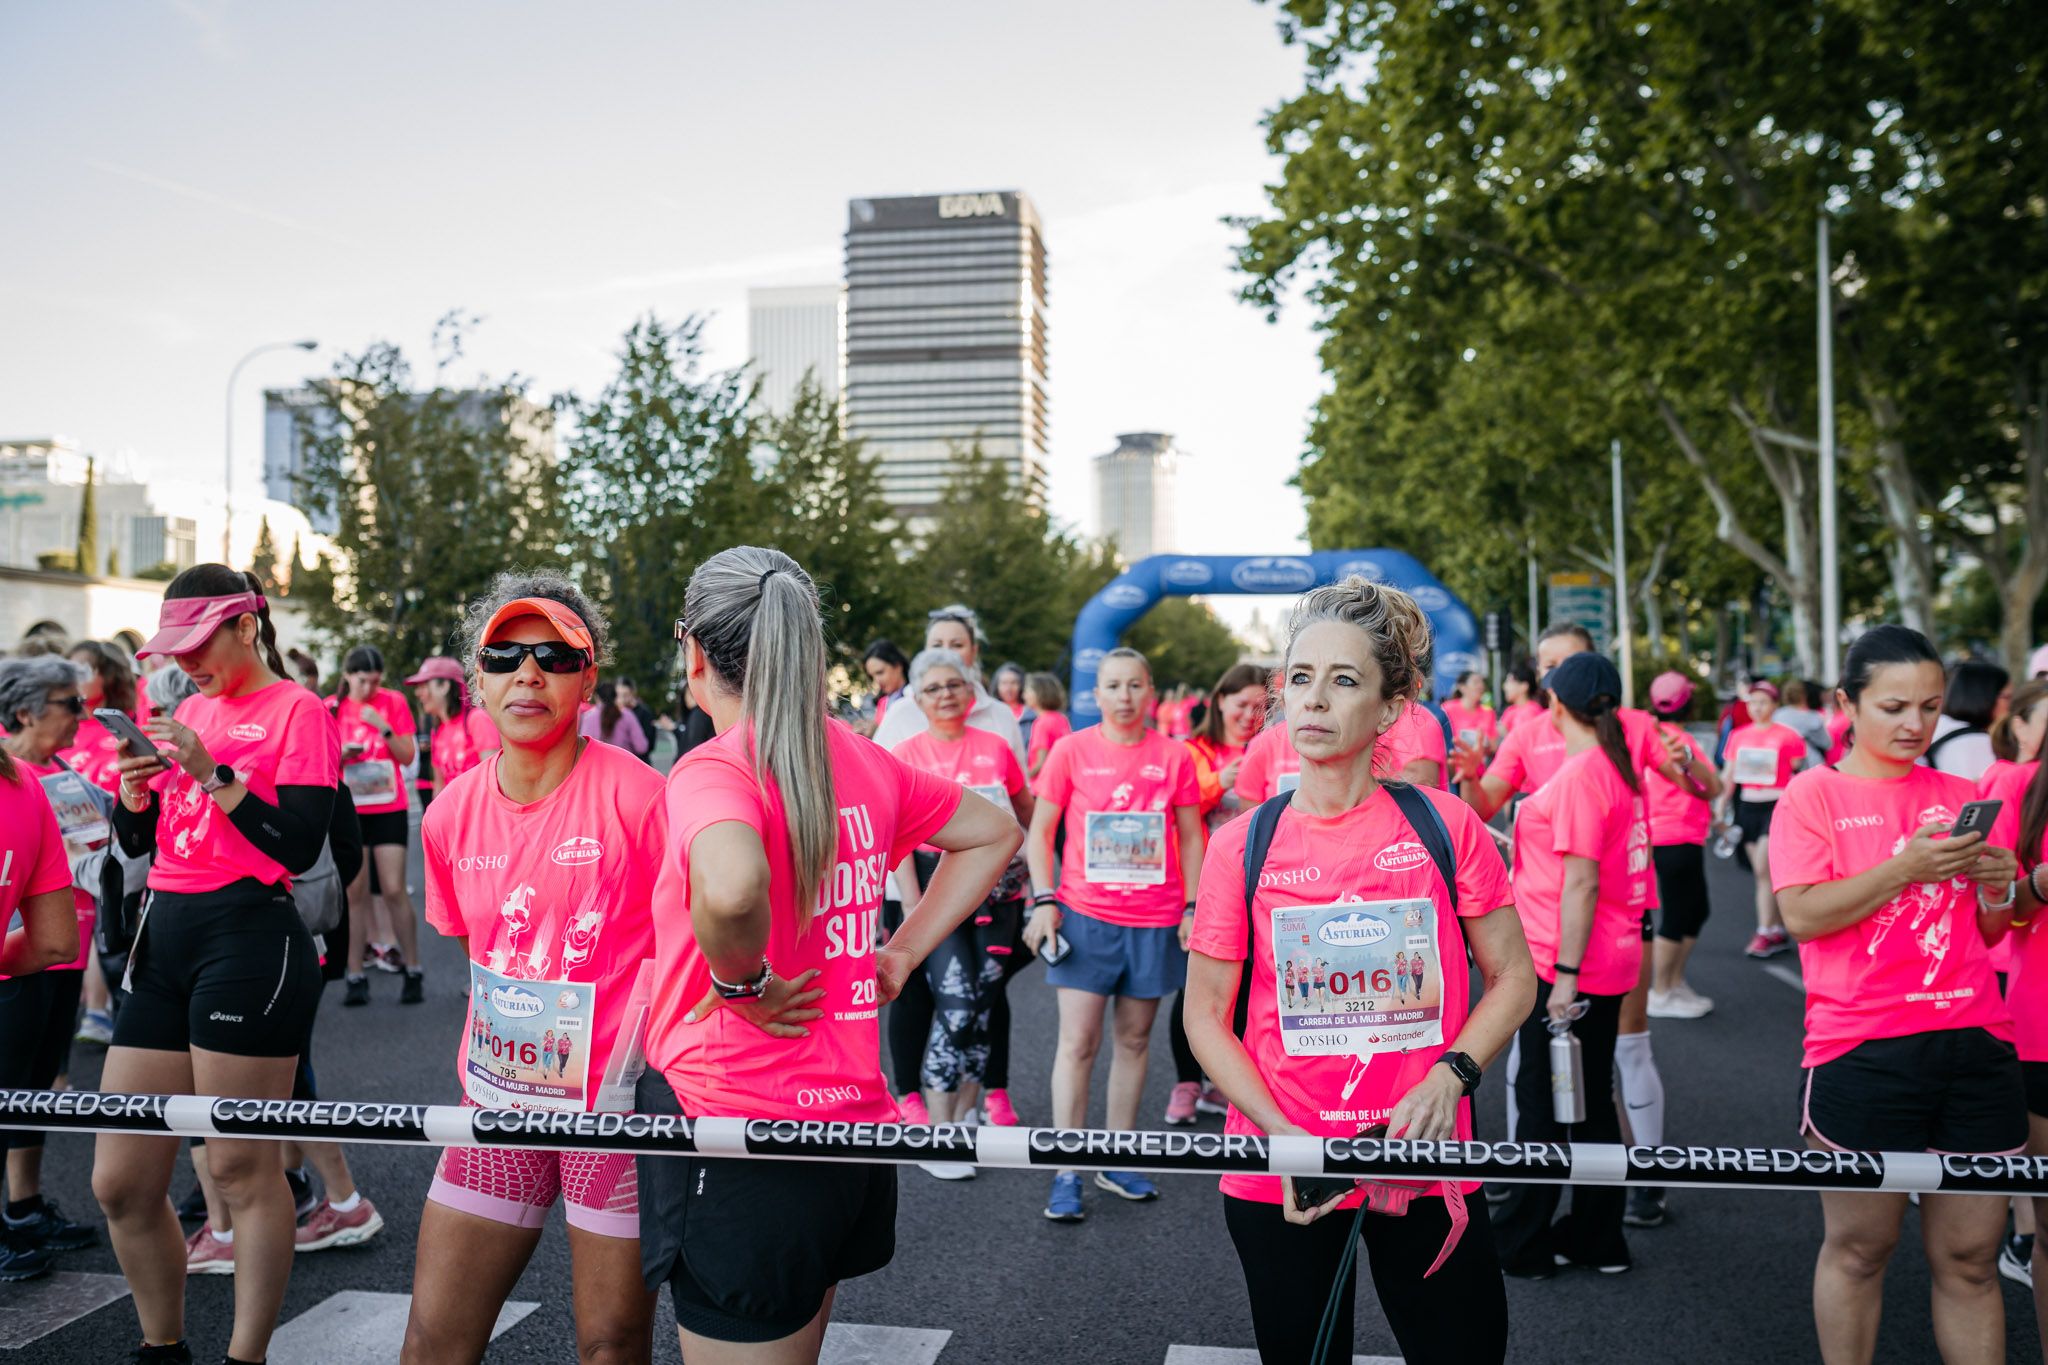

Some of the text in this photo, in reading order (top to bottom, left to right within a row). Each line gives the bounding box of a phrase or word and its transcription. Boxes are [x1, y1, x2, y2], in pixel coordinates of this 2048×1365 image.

[840, 804, 874, 852] TU
[1835, 814, 1884, 831] OYSHO
[556, 849, 600, 860] ASTURIANA
[1380, 852, 1427, 867] ASTURIANA
[458, 854, 508, 872] OYSHO
[1258, 866, 1321, 888] OYSHO
[1281, 922, 1307, 932] SUMA
[1324, 926, 1386, 940] ASTURIANA
[1329, 968, 1392, 995] 016
[851, 978, 877, 1005] 20
[1345, 1000, 1375, 1012] 3212
[1298, 1011, 1424, 1027] CARRERA DE LA MUJER MADRID
[1299, 1033, 1348, 1047] OYSHO
[1381, 1030, 1425, 1043] Santander
[491, 1035, 537, 1065] 016
[473, 1065, 491, 1080] CARRERA
[491, 1075, 498, 1085] DE
[498, 1077, 506, 1087] LA
[506, 1081, 529, 1092] MUJER
[535, 1086, 566, 1096] MADRID
[500, 1066, 517, 1079] 795
[472, 1081, 499, 1103] OYSHO
[797, 1084, 862, 1107] OYSHO
[1320, 1110, 1356, 1121] CARRERA
[1358, 1110, 1369, 1121] DE
[1371, 1109, 1381, 1120] LA
